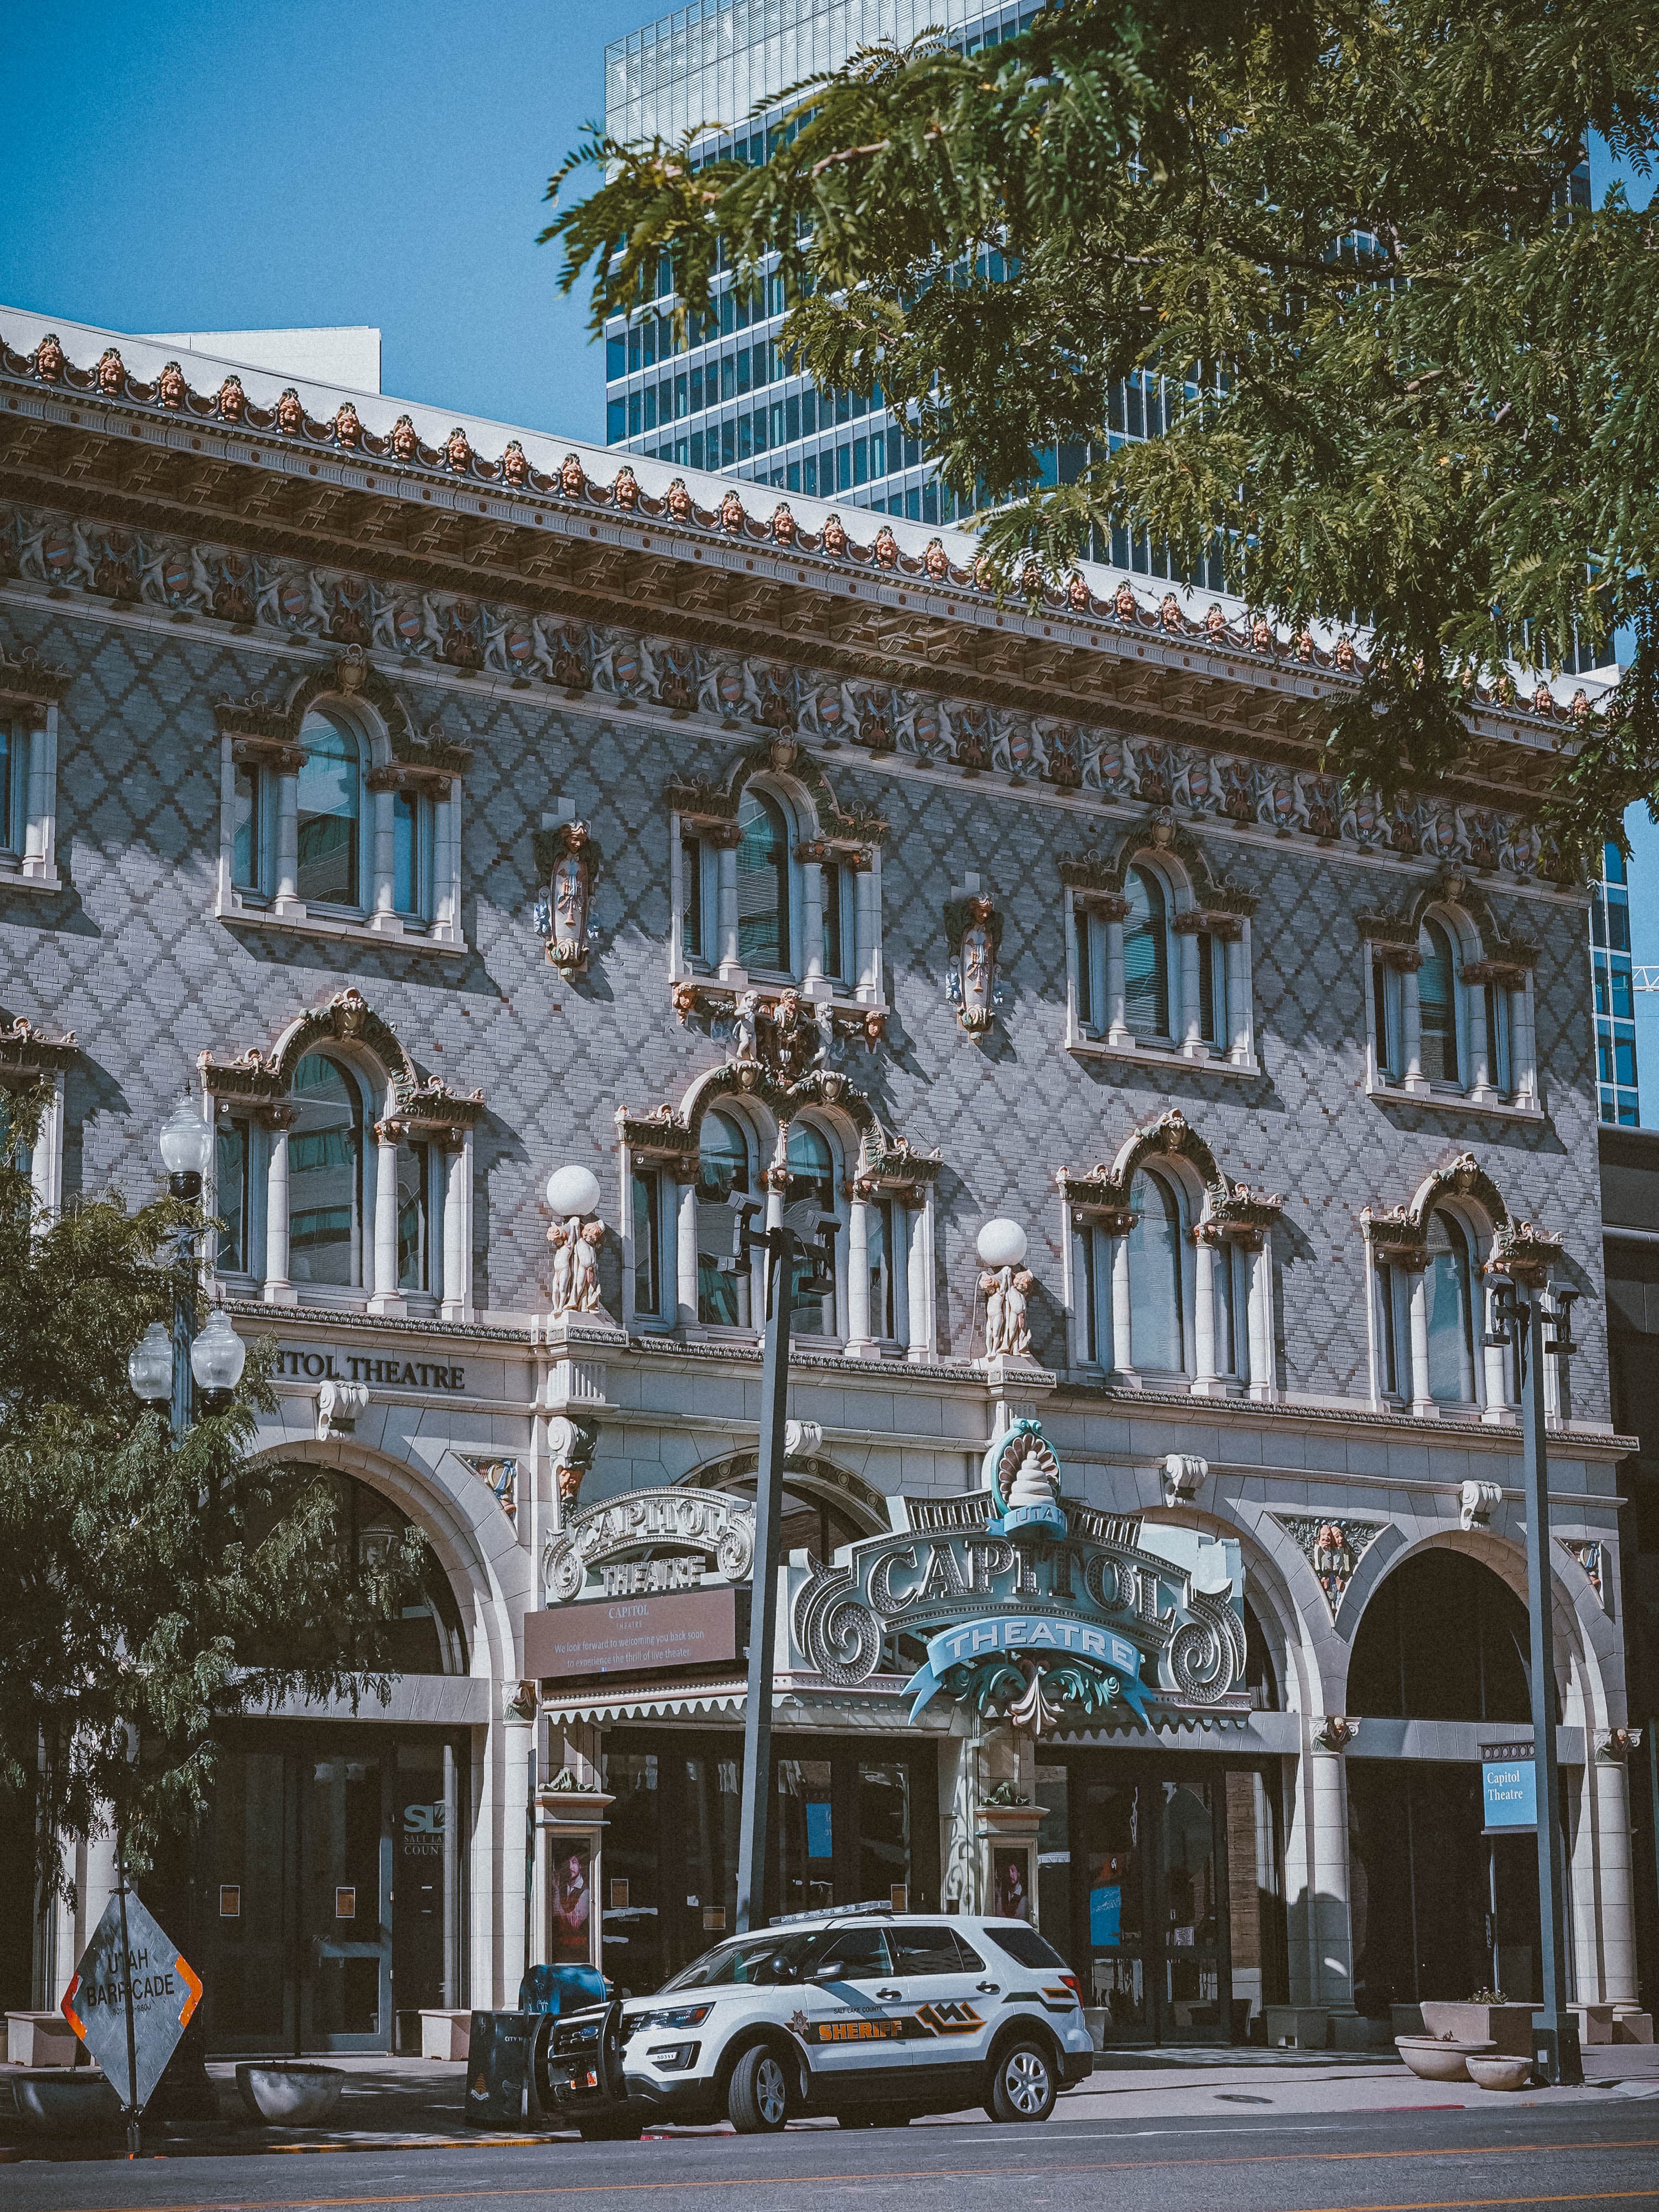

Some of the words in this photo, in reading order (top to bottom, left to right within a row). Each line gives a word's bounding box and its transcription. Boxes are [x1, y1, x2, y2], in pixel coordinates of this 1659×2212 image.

[278, 1351, 345, 1381] ITOL
[347, 1355, 466, 1389] THEATRE
[1016, 1506, 1065, 1524] UTAH
[575, 1498, 727, 1556] CAPITOL
[600, 1555, 706, 1596] THEATRE
[867, 1538, 1177, 1634] CAPITOL
[609, 1604, 649, 1620] CAPITOL
[616, 1620, 642, 1630] THEATRE
[555, 1644, 565, 1654] We
[567, 1642, 580, 1653] look
[583, 1641, 609, 1651] forward
[610, 1640, 617, 1648] to
[619, 1636, 654, 1647] welcoming
[656, 1634, 669, 1646] you
[670, 1631, 685, 1642] back
[945, 1621, 1133, 1672] THEATRE
[613, 1653, 625, 1663] the
[626, 1650, 642, 1662] thrill
[643, 1649, 651, 1660] of
[652, 1649, 663, 1660] live
[1487, 1770, 1520, 1787] Capitol
[1488, 1789, 1523, 1801] Theatre
[404, 1845, 444, 1855] COUN
[819, 2021, 902, 2041] SHERIFF
